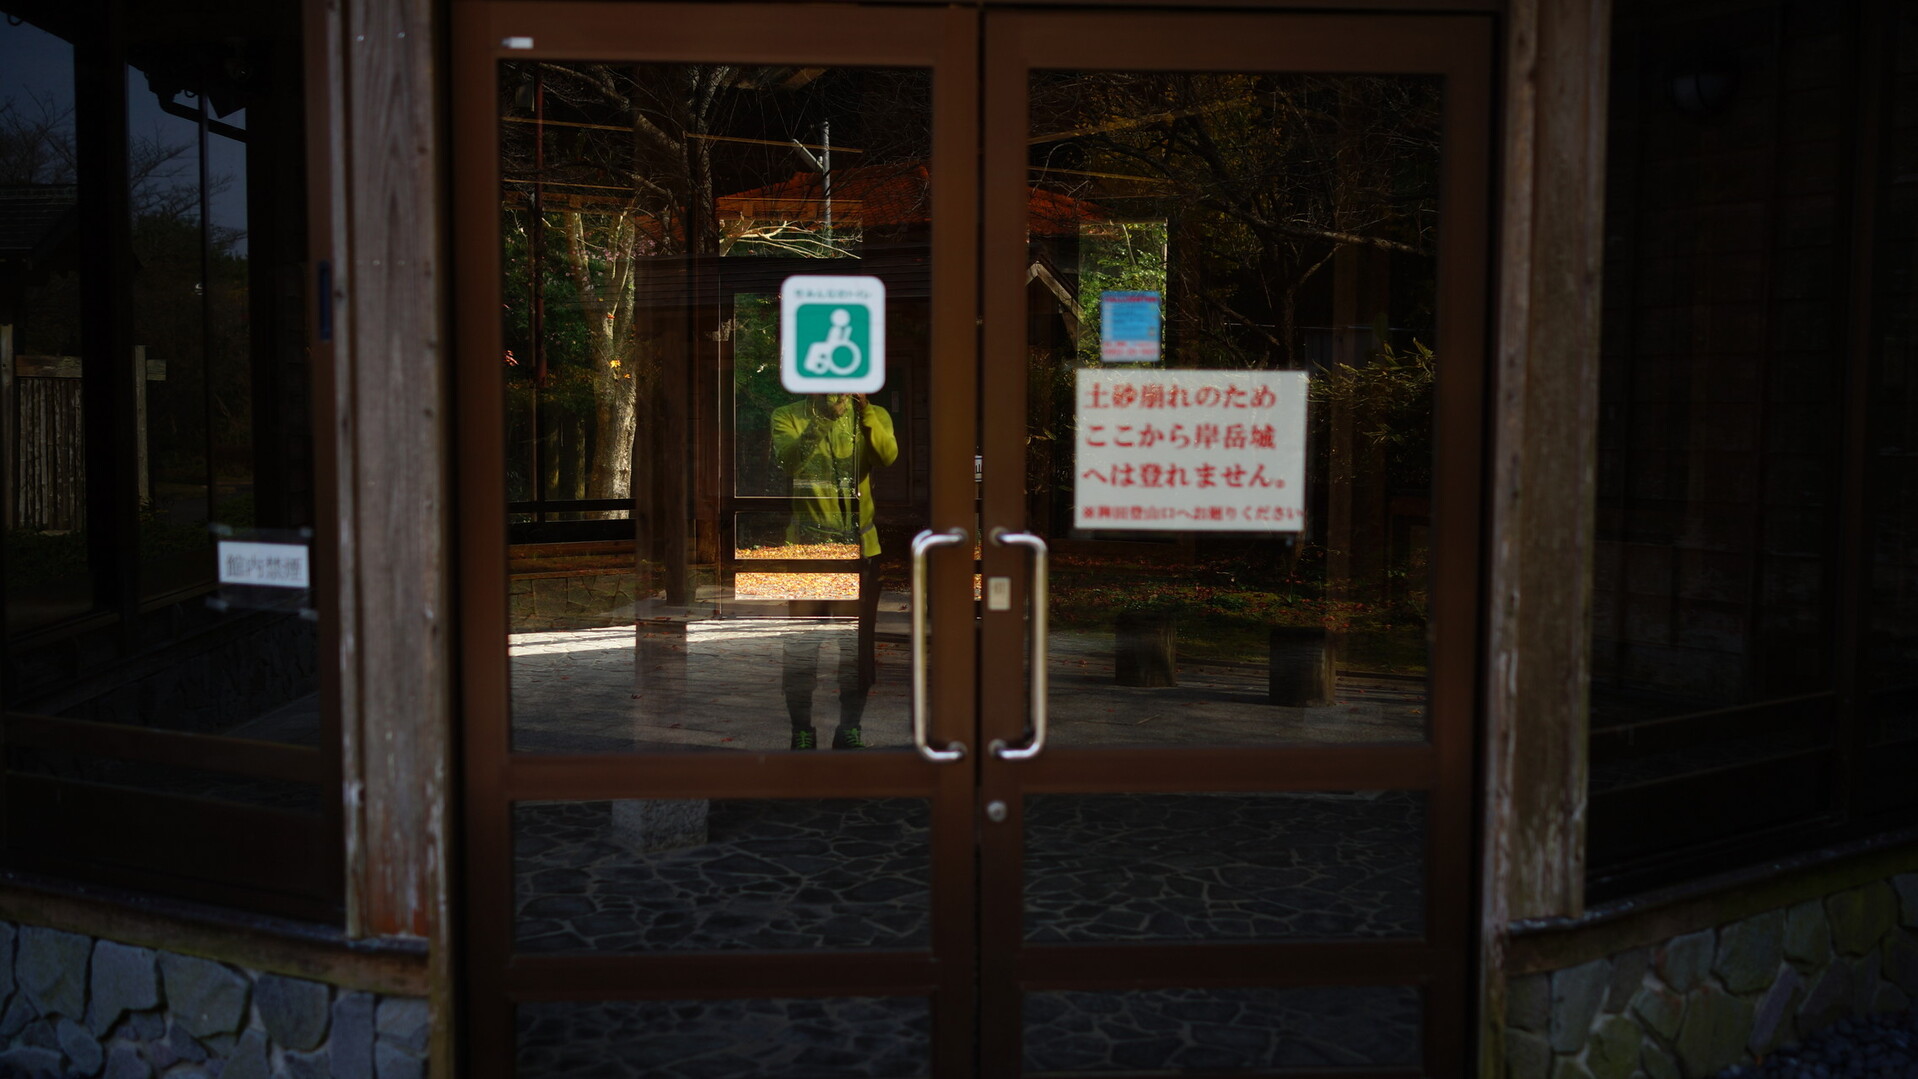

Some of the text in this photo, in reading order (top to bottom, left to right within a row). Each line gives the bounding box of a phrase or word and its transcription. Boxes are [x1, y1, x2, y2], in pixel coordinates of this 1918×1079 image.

[1083, 382, 1277, 409] 土砂崩れのため
[1085, 423, 1277, 450] ここから岸岳城
[1081, 462, 1287, 489] へは登れません。
[225, 553, 304, 581] 館内禁煙
